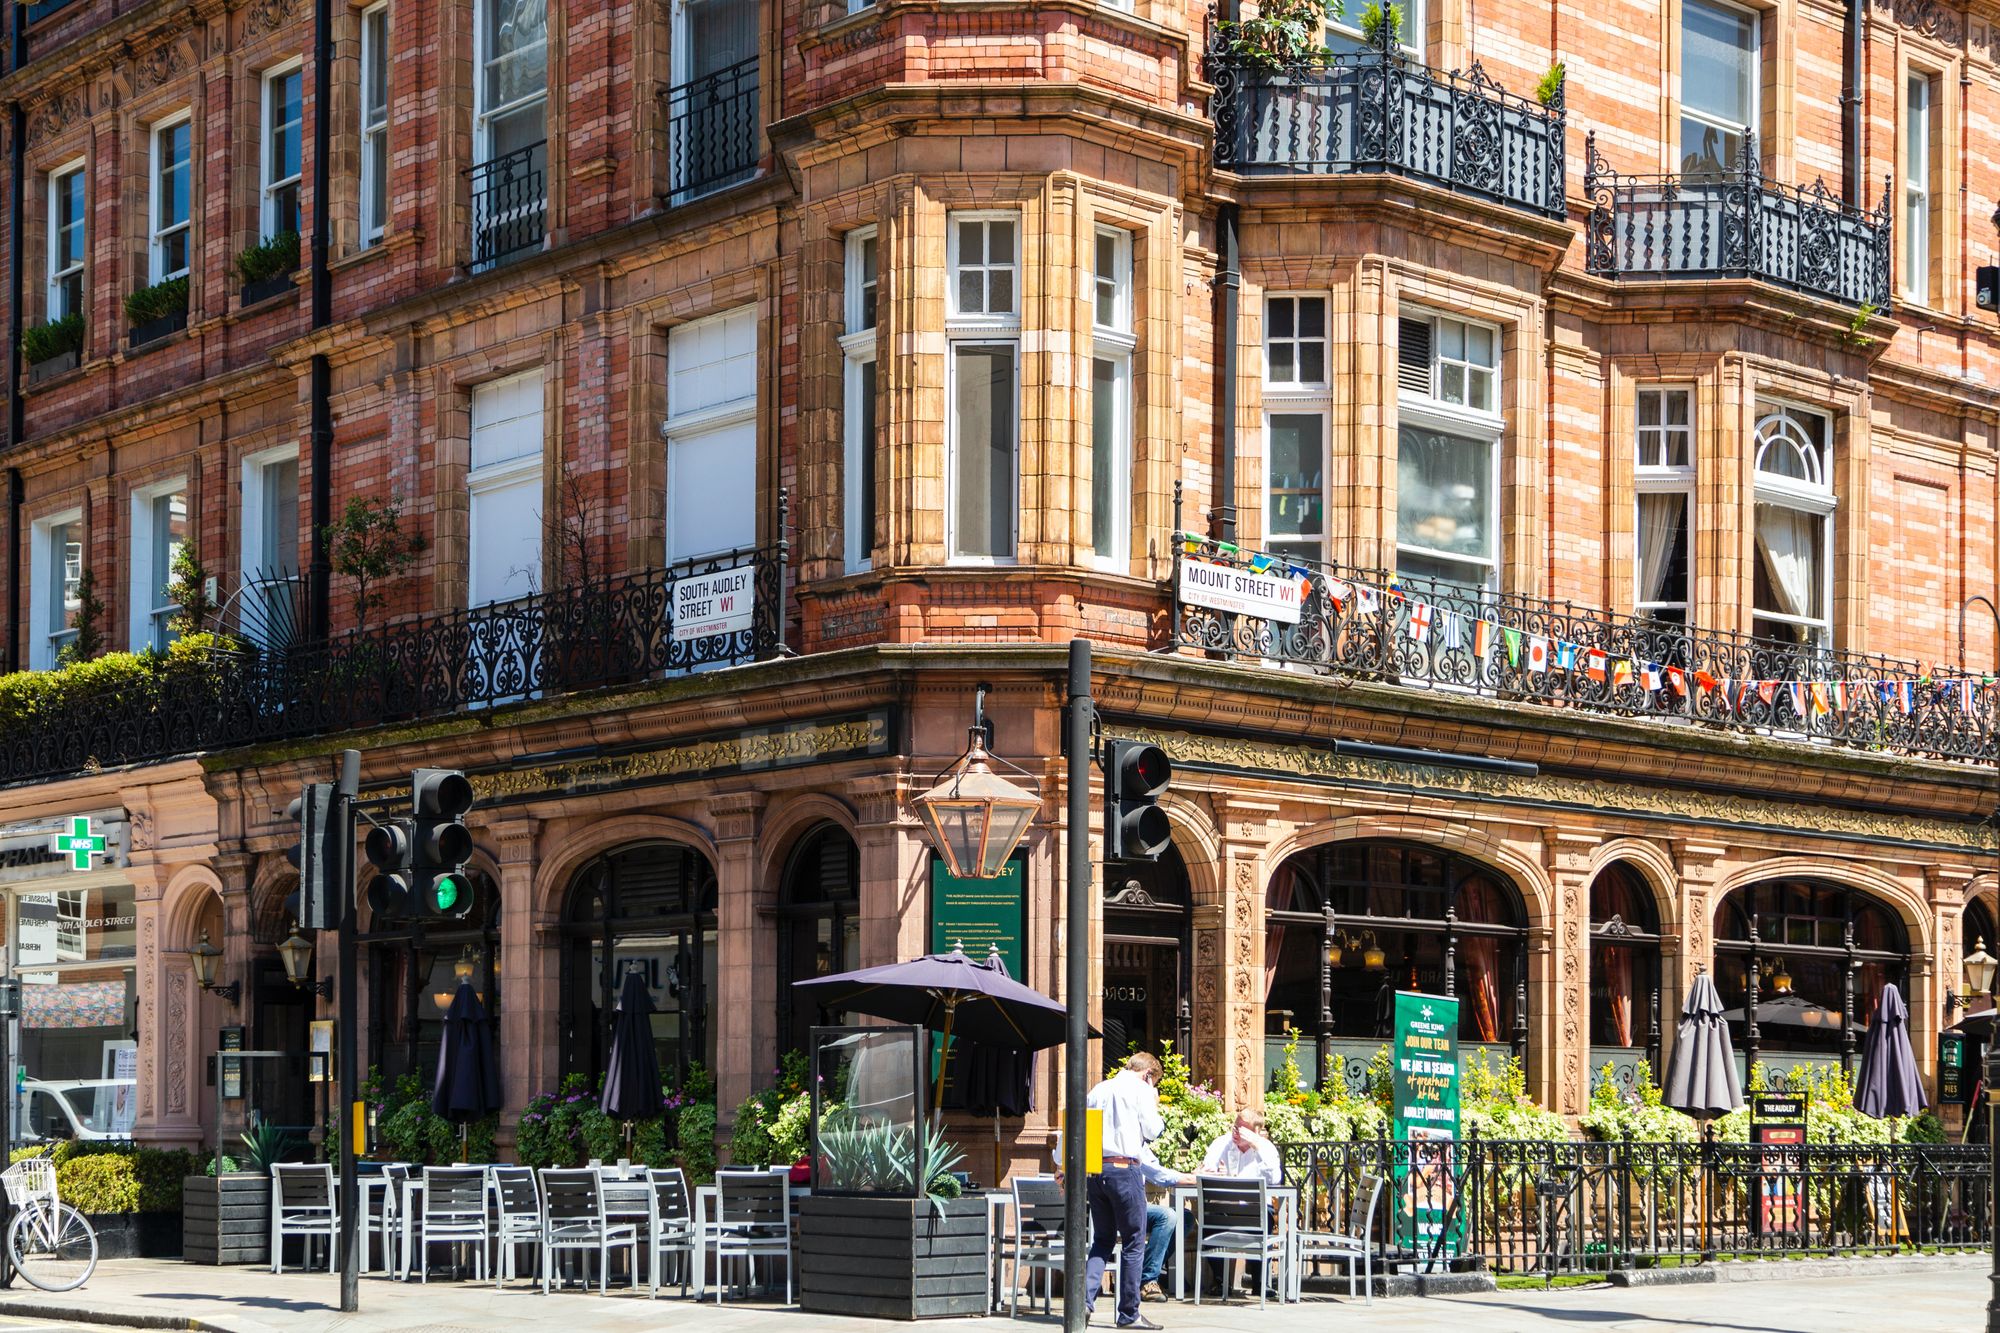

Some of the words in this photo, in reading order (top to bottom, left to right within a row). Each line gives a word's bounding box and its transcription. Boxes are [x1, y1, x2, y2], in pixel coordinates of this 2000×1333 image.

[680, 582, 709, 601] SOUTH
[712, 574, 747, 595] AUDLEY
[1188, 567, 1231, 589] MOUNT
[1235, 577, 1276, 598] STREET
[1279, 585, 1294, 602] W1
[680, 600, 713, 620] STREET
[720, 596, 734, 612] W1
[1188, 592, 1199, 601] CITY
[1209, 597, 1245, 610] WESTMINSTER
[679, 628, 689, 637] CITY
[689, 627, 695, 635] OF
[696, 621, 727, 634] WESTMINSTER
[70, 839, 92, 849] NHS
[105, 915, 136, 926] STREET
[1410, 1021, 1430, 1029] GREENE
[1430, 1023, 1444, 1031] KING
[1405, 1036, 1419, 1048] JOIN
[1420, 1037, 1432, 1049] OUR
[1433, 1038, 1449, 1051] TEAM
[1400, 1059, 1411, 1071] WE
[1412, 1060, 1423, 1072] ARE
[1423, 1061, 1431, 1073] IN
[1432, 1061, 1454, 1075] SEARCH
[1407, 1071, 1417, 1090] of
[1417, 1072, 1449, 1090] greatness
[1944, 1084, 1957, 1092] PIES
[1427, 1086, 1439, 1101] the
[1403, 1106, 1425, 1118] AUDLEY
[1425, 1106, 1454, 1122] (MAYFAIR)
[1764, 1104, 1774, 1112] THE
[1774, 1104, 1796, 1112] AUDLEY
